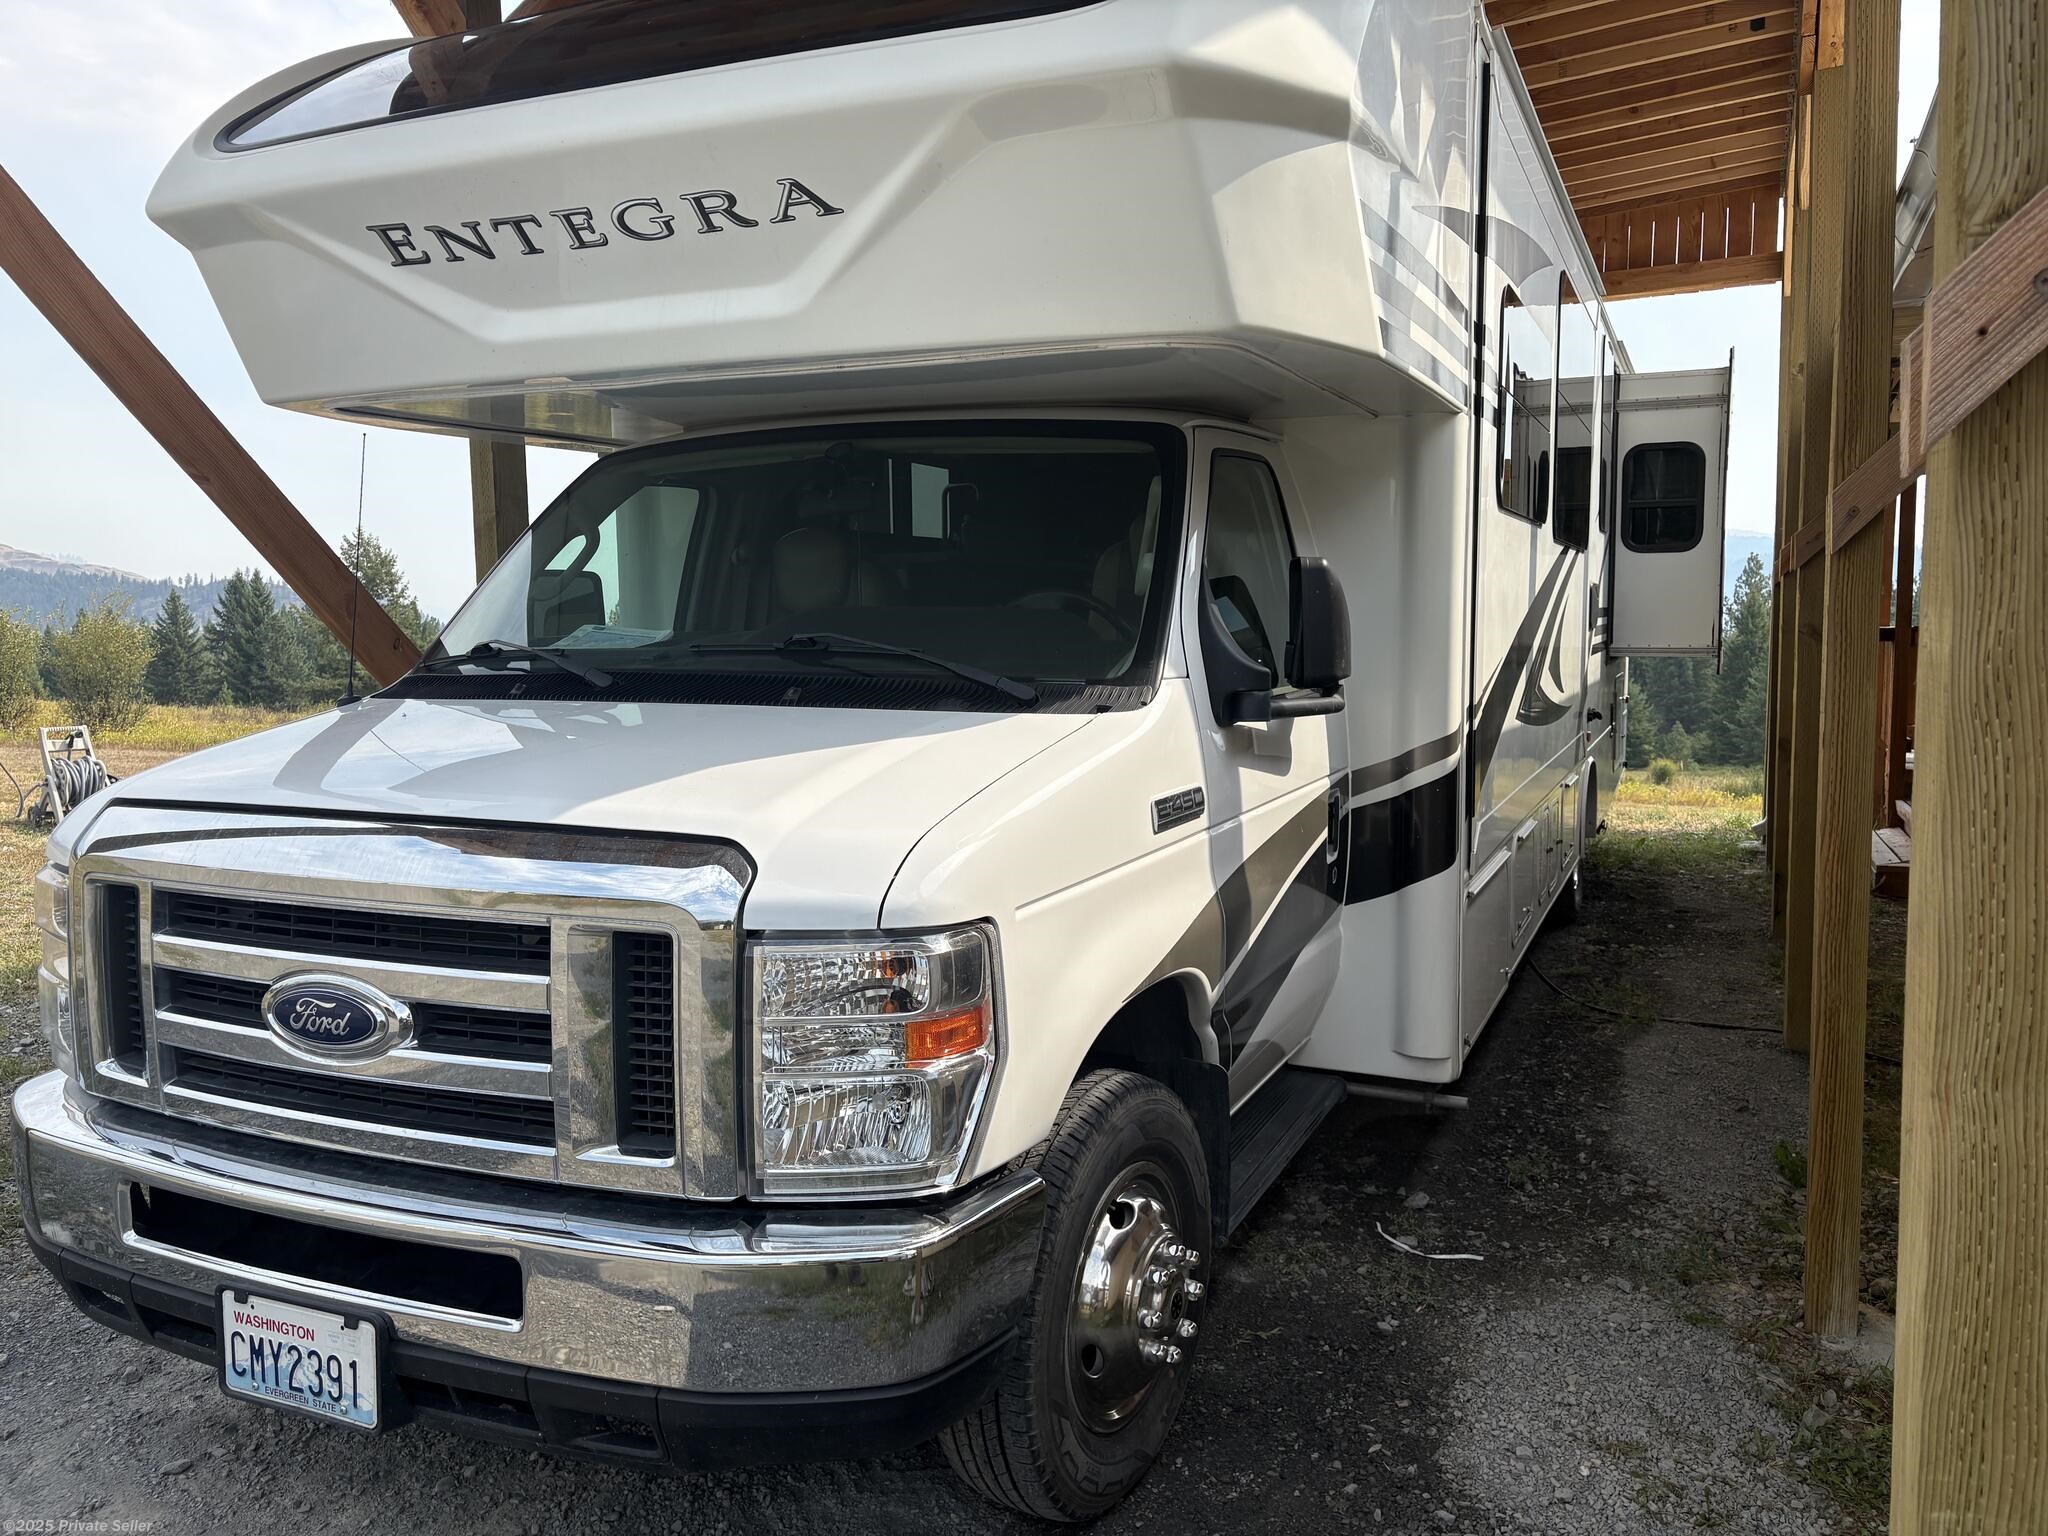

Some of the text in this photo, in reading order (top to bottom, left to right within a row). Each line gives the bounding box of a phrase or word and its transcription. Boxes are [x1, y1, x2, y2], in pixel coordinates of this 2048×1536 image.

[366, 178, 844, 267] ENTEGRA
[290, 997, 351, 1036] Ford
[233, 1310, 315, 1342] WASHINGTON
[230, 1330, 358, 1409] CMY2391
[264, 1385, 337, 1413] EVERGREEN STATE
